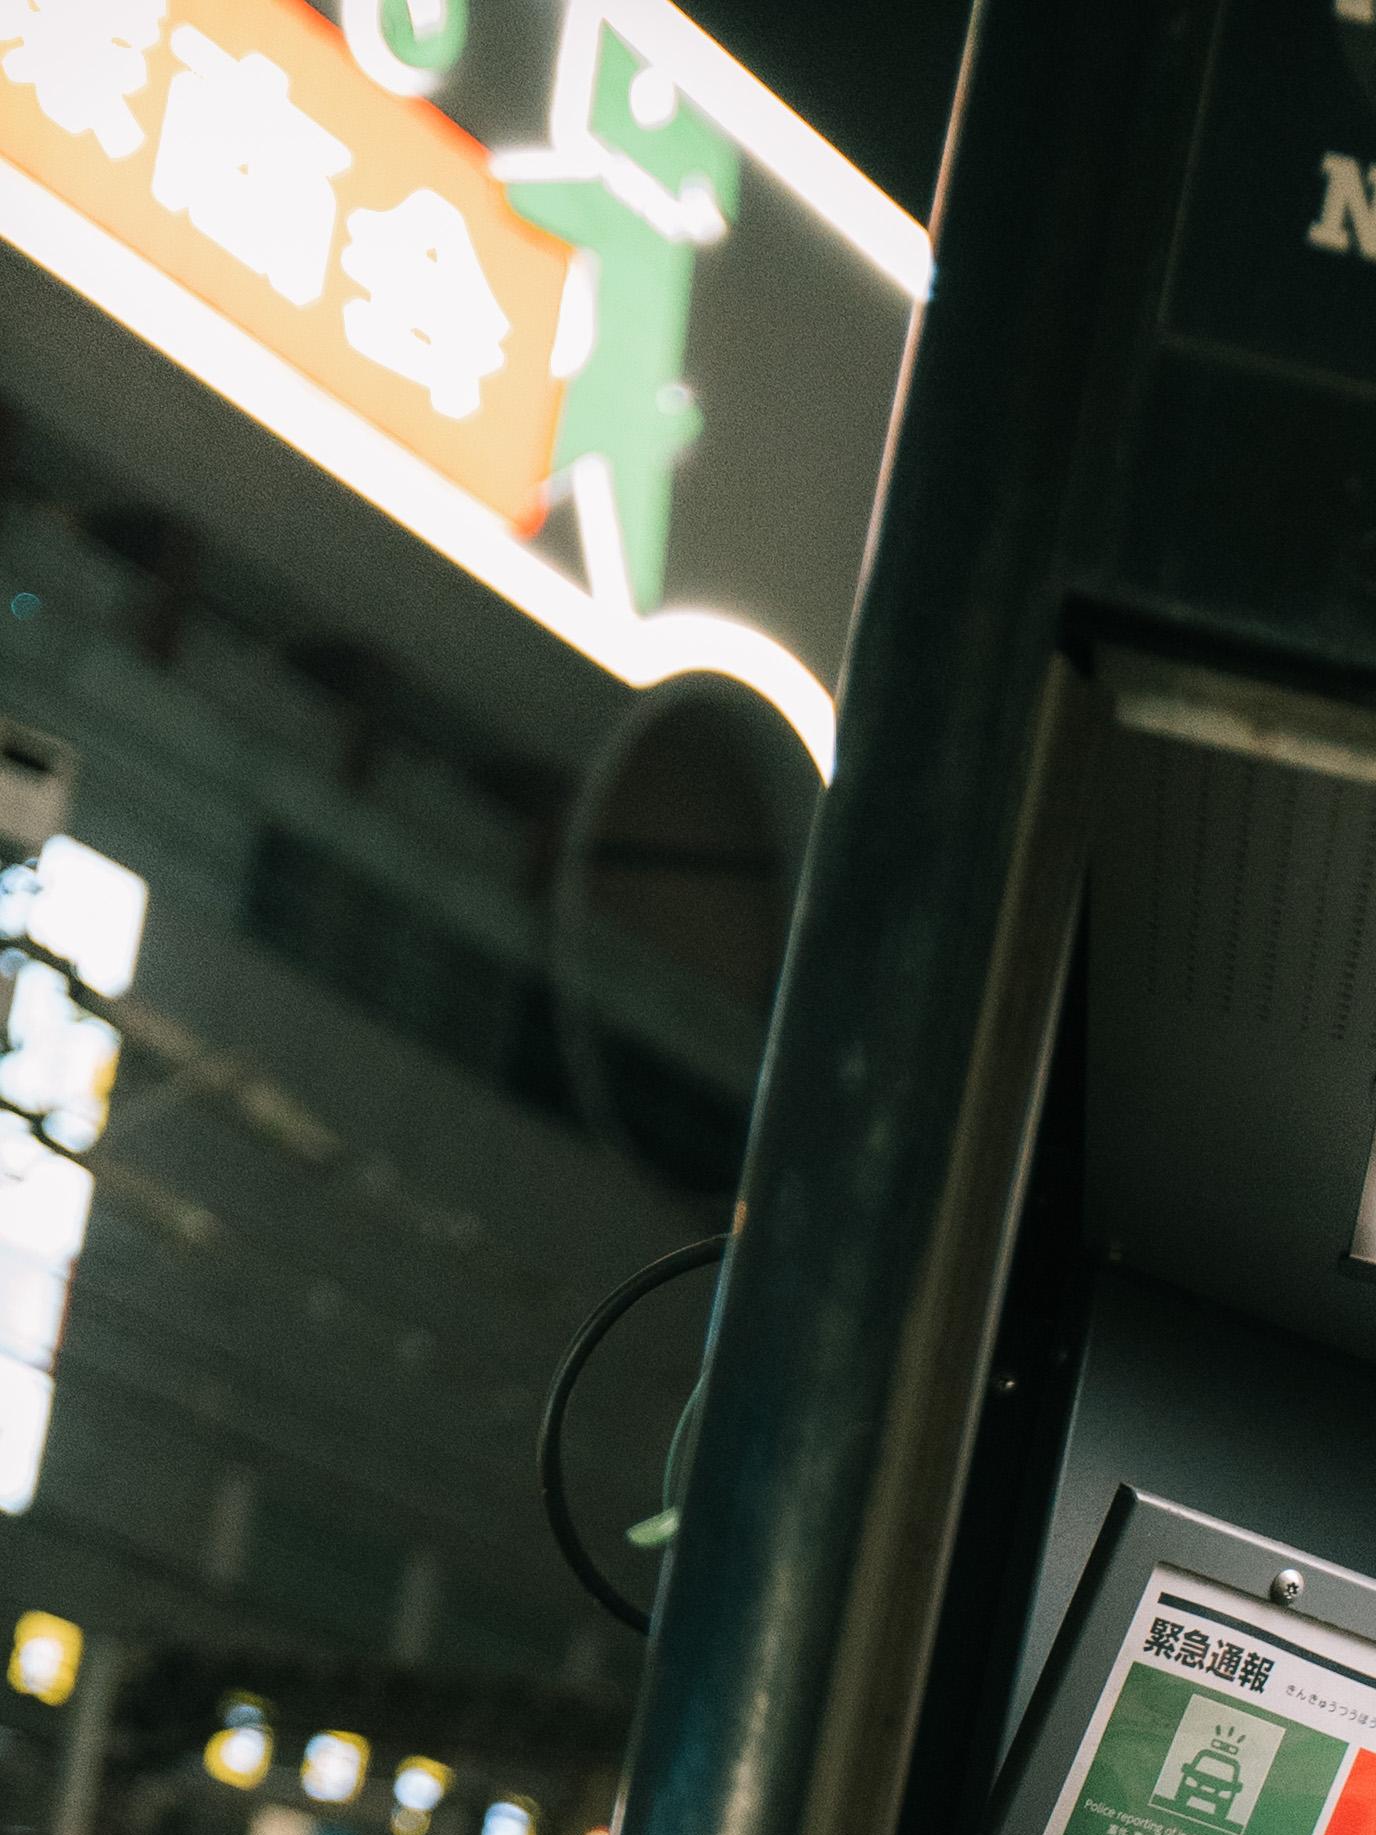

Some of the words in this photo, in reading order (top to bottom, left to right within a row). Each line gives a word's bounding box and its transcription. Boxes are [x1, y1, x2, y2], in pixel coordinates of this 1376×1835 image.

[1143, 1617, 1275, 1693] 緊急通報
[1084, 1798, 1116, 1818] Police
